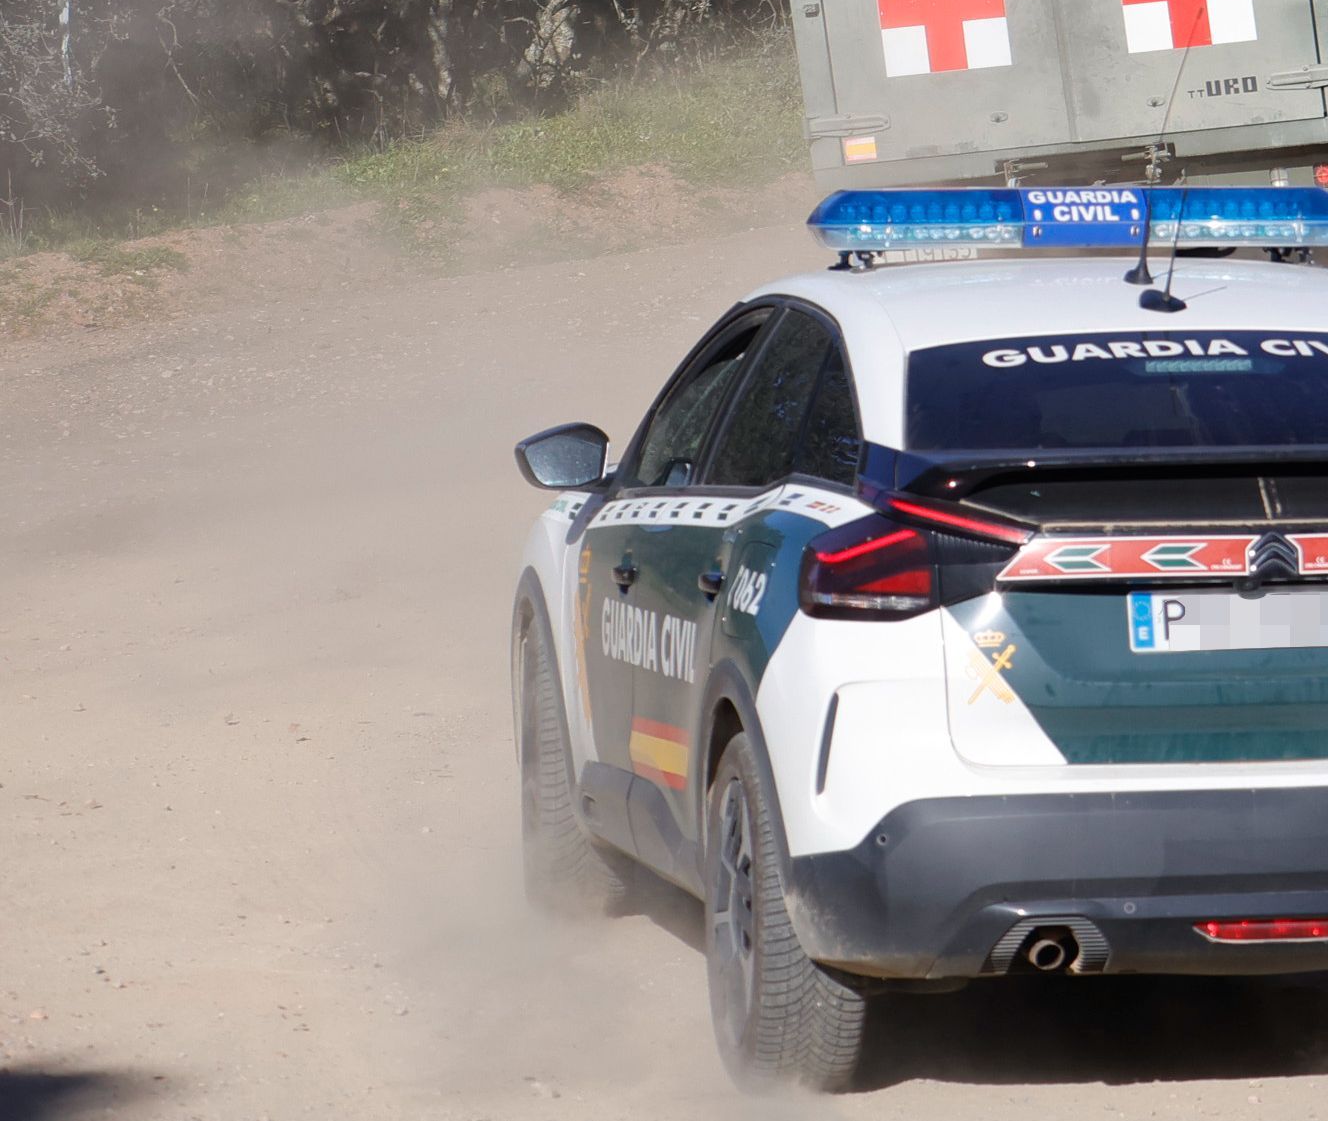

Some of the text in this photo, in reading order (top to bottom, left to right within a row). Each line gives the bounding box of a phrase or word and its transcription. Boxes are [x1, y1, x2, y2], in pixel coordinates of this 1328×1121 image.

[1027, 190, 1138, 204] GUARDIA
[1053, 205, 1120, 222] CIVIL
[982, 338, 1249, 368] GUARDIA
[601, 597, 697, 684] GUARDIA CIVIL
[1138, 627, 1149, 640] E
